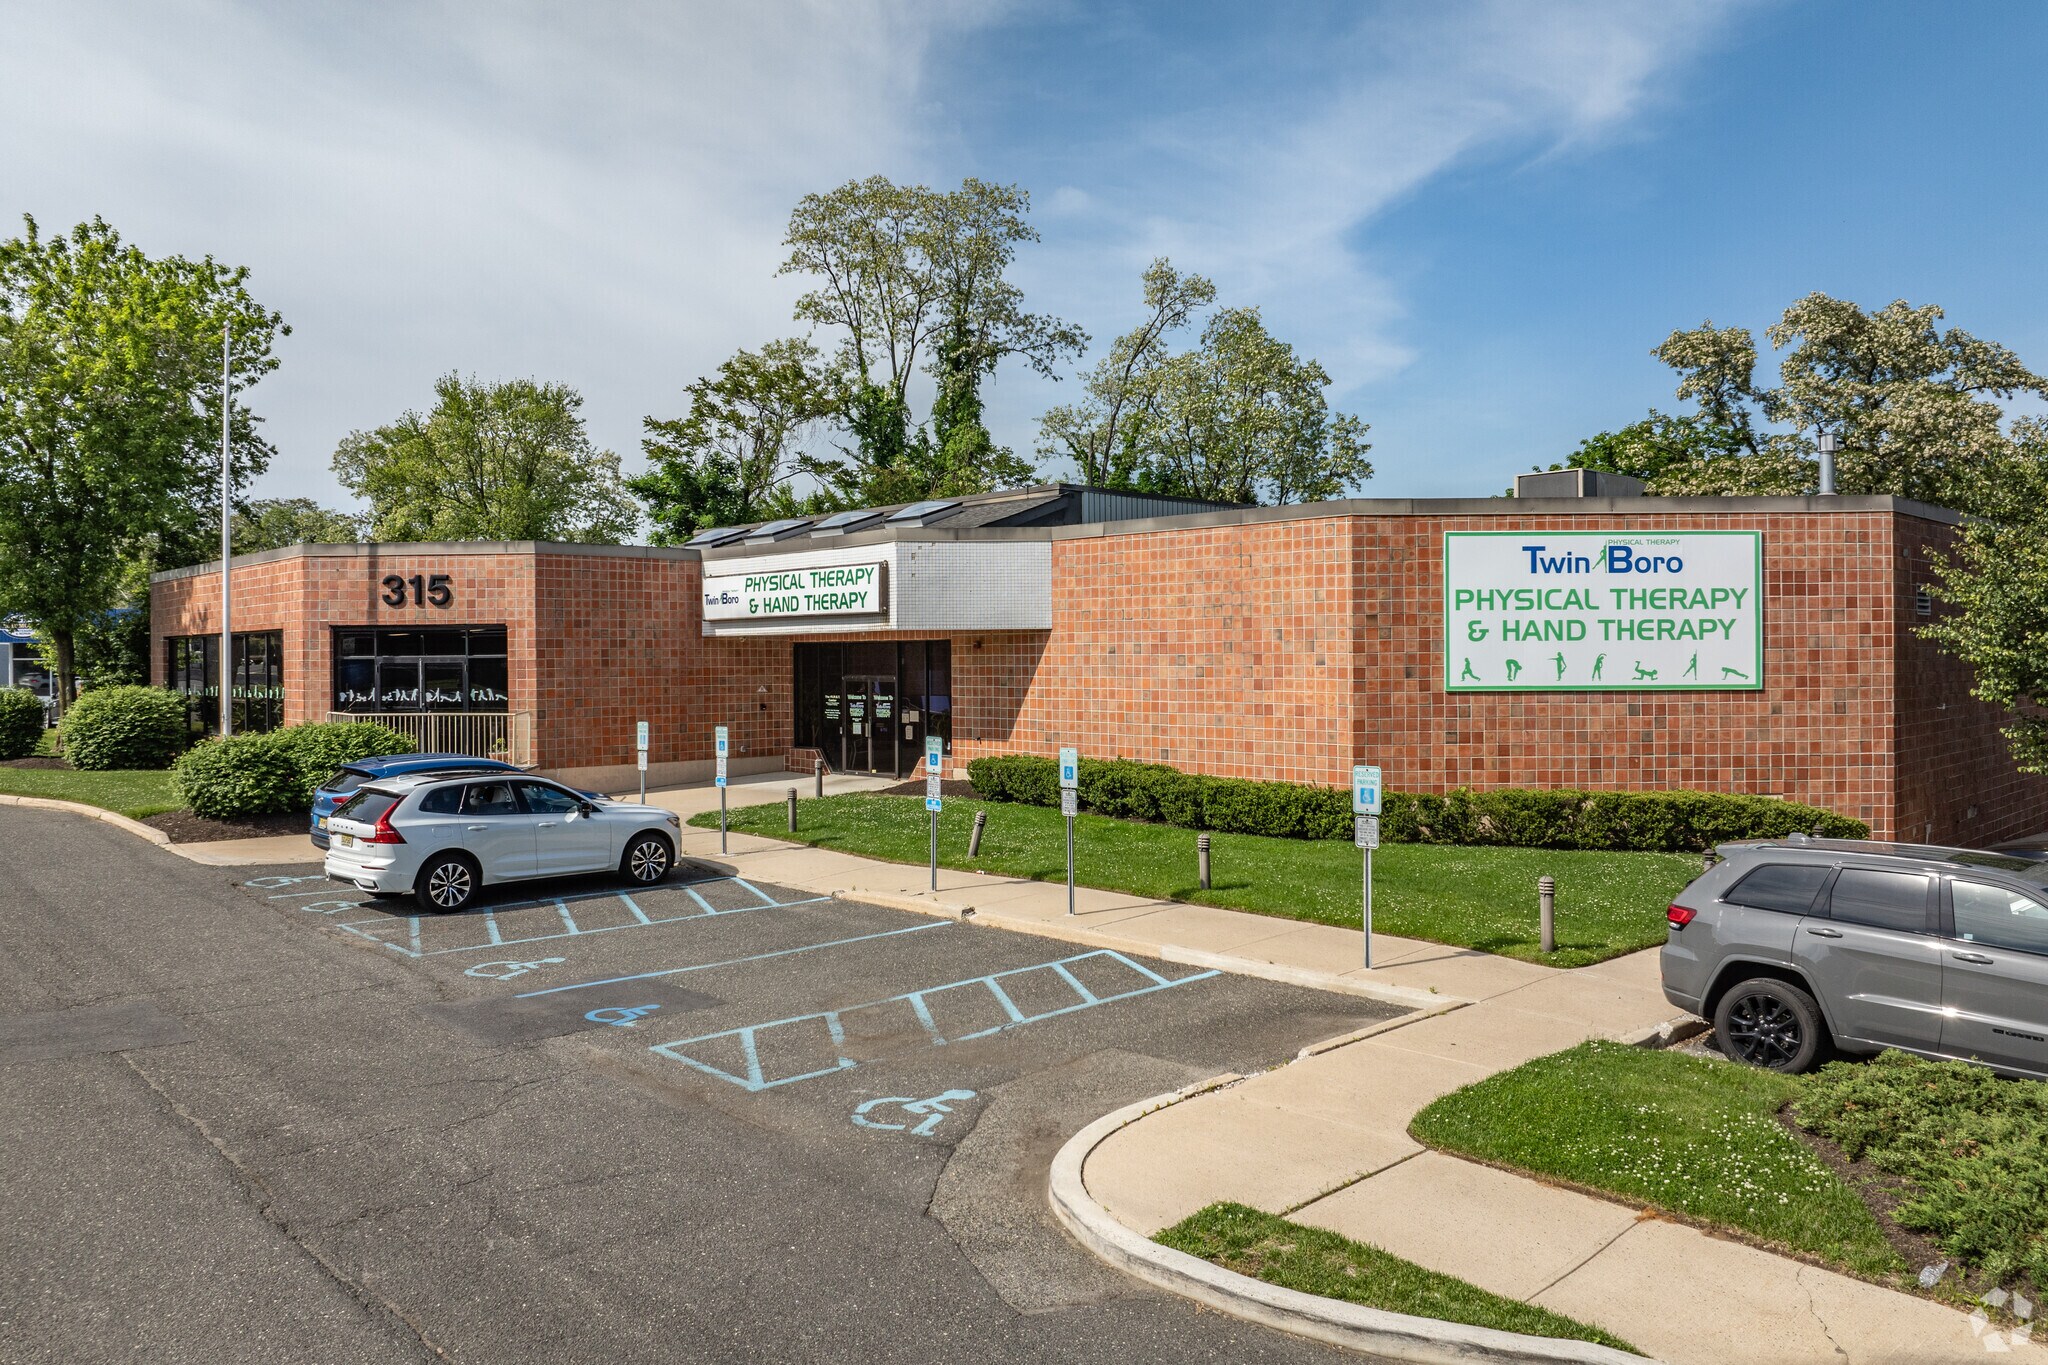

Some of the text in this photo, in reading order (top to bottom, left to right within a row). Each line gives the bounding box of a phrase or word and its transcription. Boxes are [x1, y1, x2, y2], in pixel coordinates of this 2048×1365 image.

[1522, 545, 1683, 573] Twin Boro
[382, 575, 451, 605] 315
[745, 567, 874, 592] PHYSICAL THERAPY
[704, 593, 739, 605] Twin Boro
[750, 591, 868, 614] & HAND THERAPY
[1455, 588, 1748, 610] PHYSICAL THERAPY
[1468, 618, 1737, 642] & HAND THERAPY
